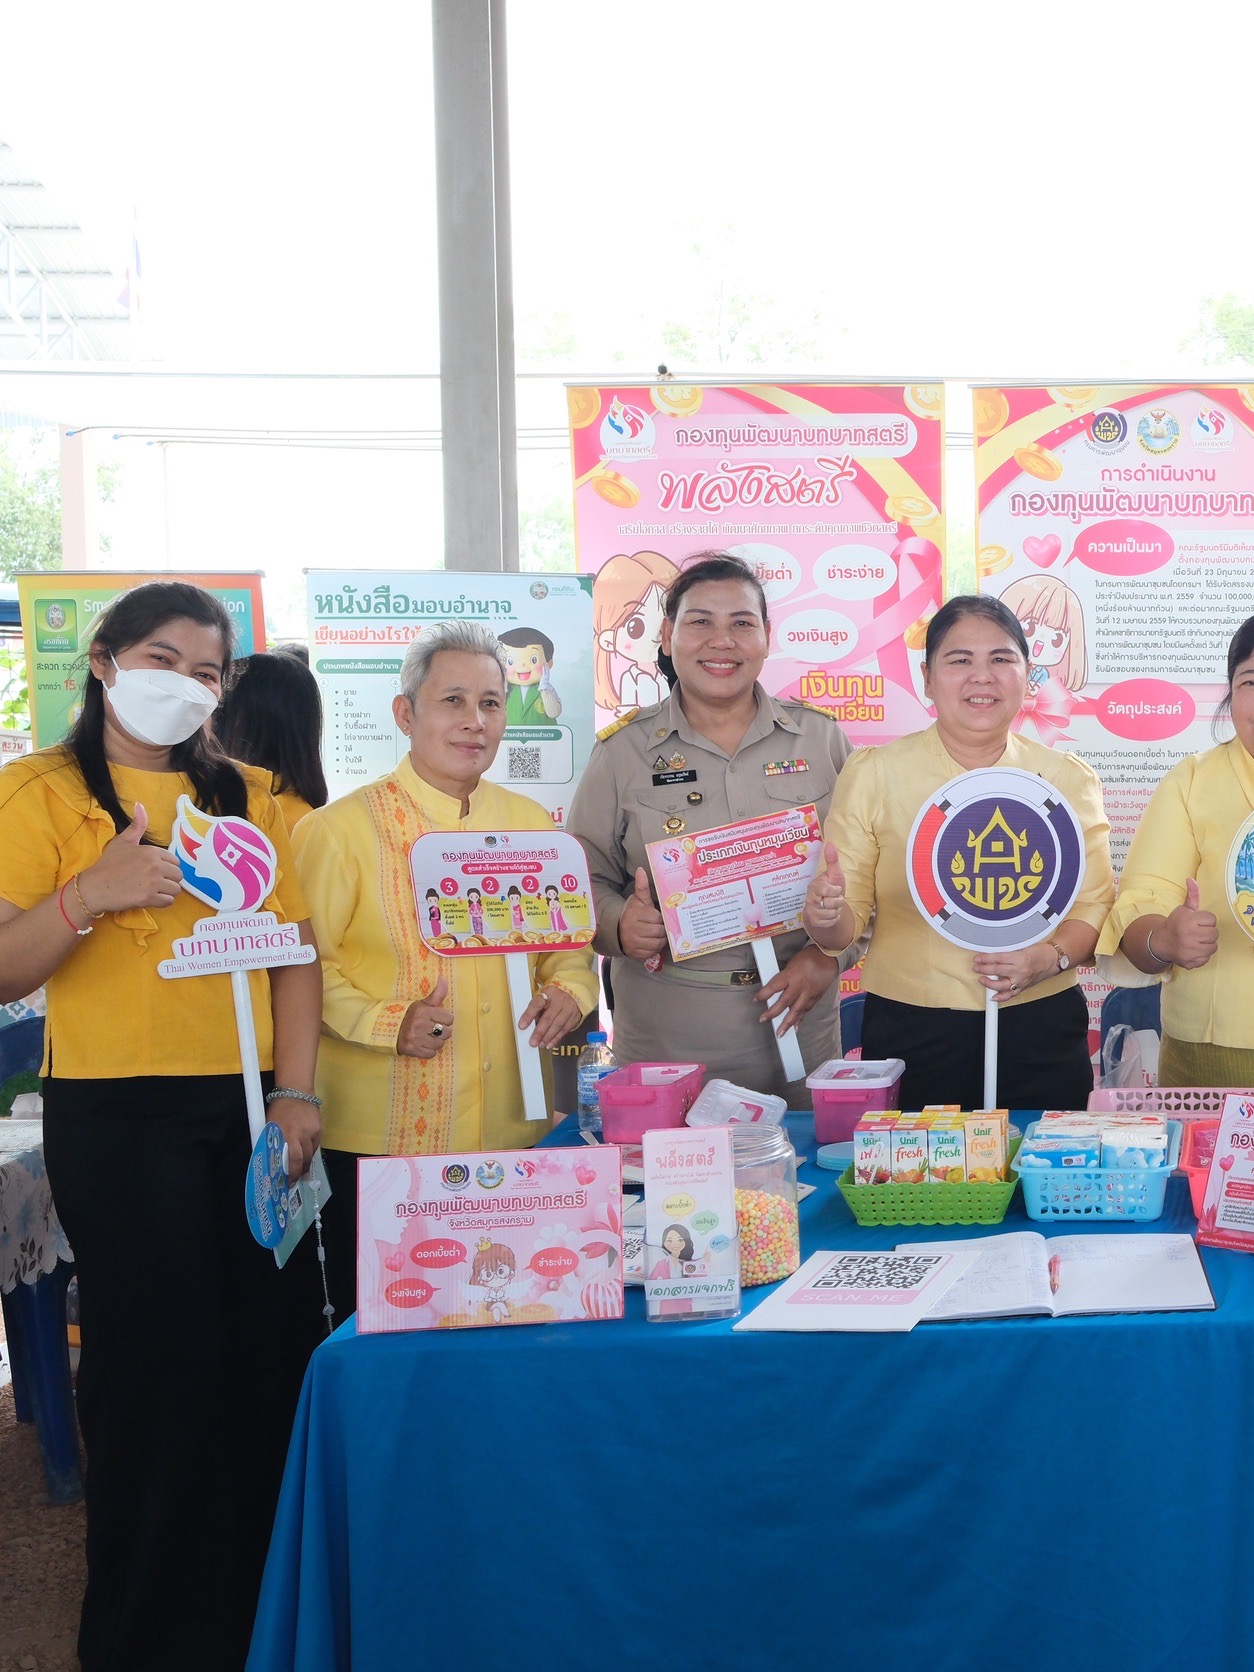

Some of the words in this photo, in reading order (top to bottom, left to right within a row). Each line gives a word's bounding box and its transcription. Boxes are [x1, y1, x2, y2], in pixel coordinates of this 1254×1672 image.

[674, 421, 908, 452] กองทุนพัฒนาบทบาทสตรี
[1100, 463, 1217, 482] การดำเนินงาน
[660, 456, 857, 511] พลังสตรี
[1088, 537, 1162, 553] ความเป็นมา
[827, 564, 885, 580] ชำระง่าย
[1204, 568, 1214, 576] 23
[314, 584, 512, 614] หนังสือมอบอำนาจ
[787, 629, 848, 645] วงเงินสูง
[37, 662, 59, 671] สะดวก
[38, 681, 61, 691] มากกว่า
[63, 679, 76, 691] 15
[801, 671, 883, 704] เงินทุน
[1107, 700, 1182, 719] วัตถุประสงค์
[697, 826, 809, 863] ประเภทเงินทุนหมุนเวียน
[442, 848, 558, 864] กองทุนพัฒนาบทบาทสตรี
[445, 881, 453, 893] 3
[487, 880, 494, 891] 2
[526, 879, 534, 890] 2
[562, 877, 576, 888] 10
[199, 916, 274, 932] กองทุนพัฒนา
[179, 927, 296, 957] บทบาทสตรี
[164, 964, 185, 973] Thai
[187, 959, 222, 971] Women
[224, 953, 285, 969] Empowerment
[288, 949, 312, 960] Funds
[972, 1128, 993, 1136] Unif
[900, 1137, 918, 1145] Unif
[937, 1136, 956, 1145] Unif
[969, 1138, 997, 1153] fresh
[656, 1146, 715, 1169] พลังสตรี
[895, 1146, 925, 1162] fresh
[933, 1146, 962, 1162] fresh
[395, 1189, 588, 1219] กองทุนพัฒนาบทบาทสตรี
[448, 1215, 535, 1230] จังหวัดสมุทรสงคราม
[416, 1244, 461, 1259] ดอกเบี้ยต่ำ
[538, 1256, 572, 1267] ชำระง่าย
[392, 1287, 426, 1299] วงเงินสูง
[649, 1279, 735, 1296] เอกสารแจกฟรี
[869, 1294, 905, 1302] ME
